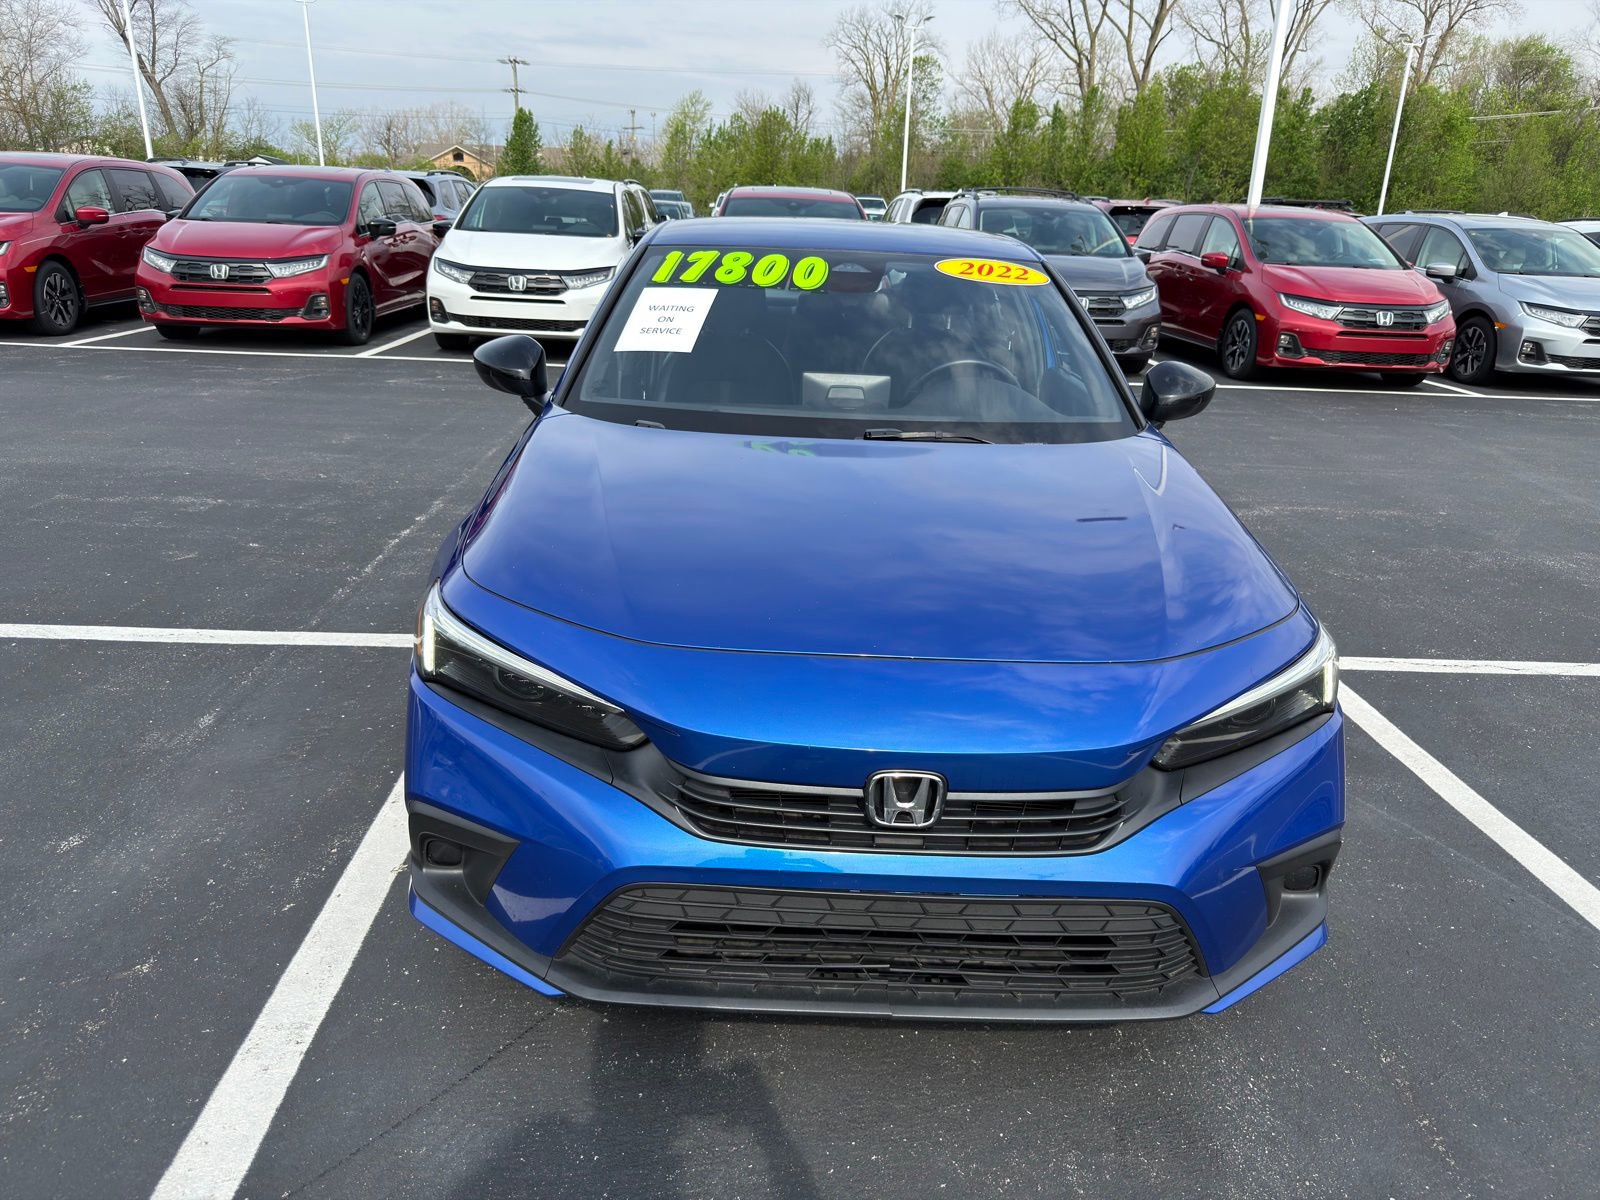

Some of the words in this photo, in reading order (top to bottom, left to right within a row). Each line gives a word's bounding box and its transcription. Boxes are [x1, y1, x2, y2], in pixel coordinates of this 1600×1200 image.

[651, 251, 829, 290] 17800
[959, 262, 1029, 280] 2022
[639, 327, 682, 335] SERVICE
